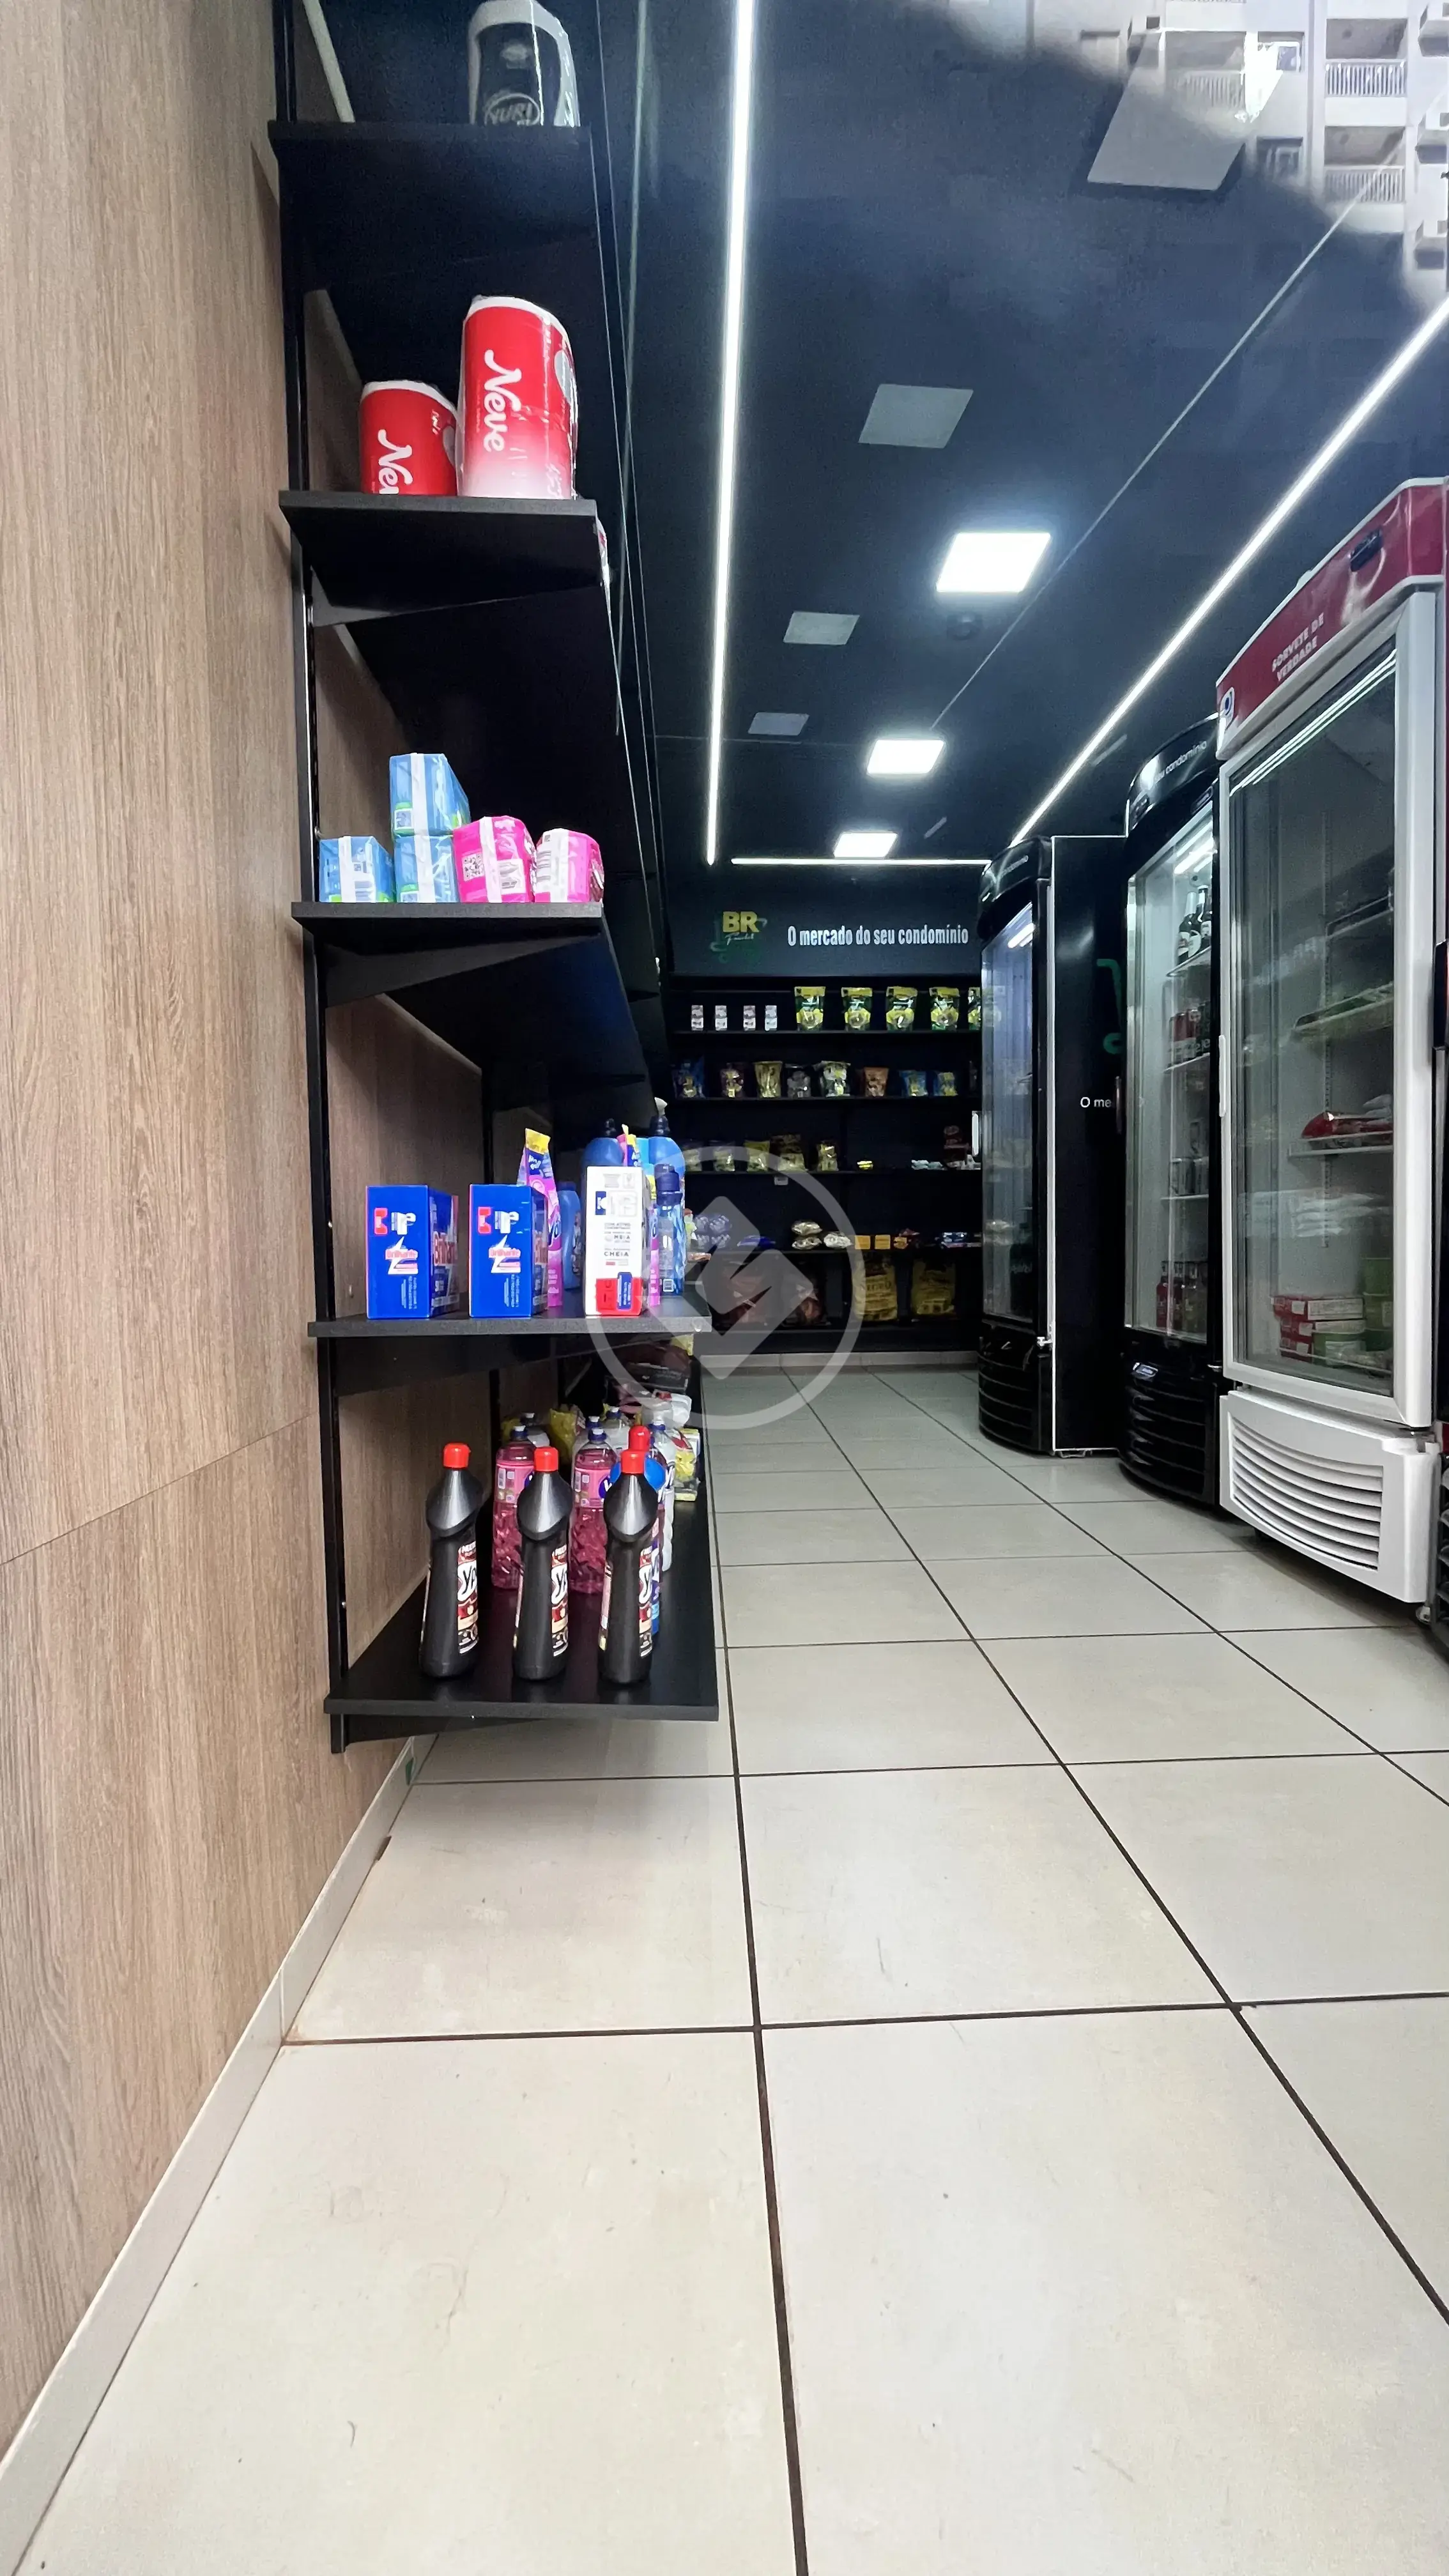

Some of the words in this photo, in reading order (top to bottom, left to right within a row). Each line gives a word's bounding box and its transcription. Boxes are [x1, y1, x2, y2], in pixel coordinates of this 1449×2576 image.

[484, 349, 522, 452] Neve
[378, 429, 413, 494] Ne
[1272, 626, 1309, 673] SORVETE
[1311, 612, 1324, 634] DE
[1277, 635, 1318, 682] VERDADE
[723, 911, 760, 933] BR
[788, 926, 797, 946] O
[800, 925, 853, 946] mercado
[856, 925, 871, 945] do
[873, 928, 895, 945] seu
[898, 924, 969, 945] condomínio
[1080, 1096, 1091, 1108] O
[1094, 1099, 1112, 1107] me
